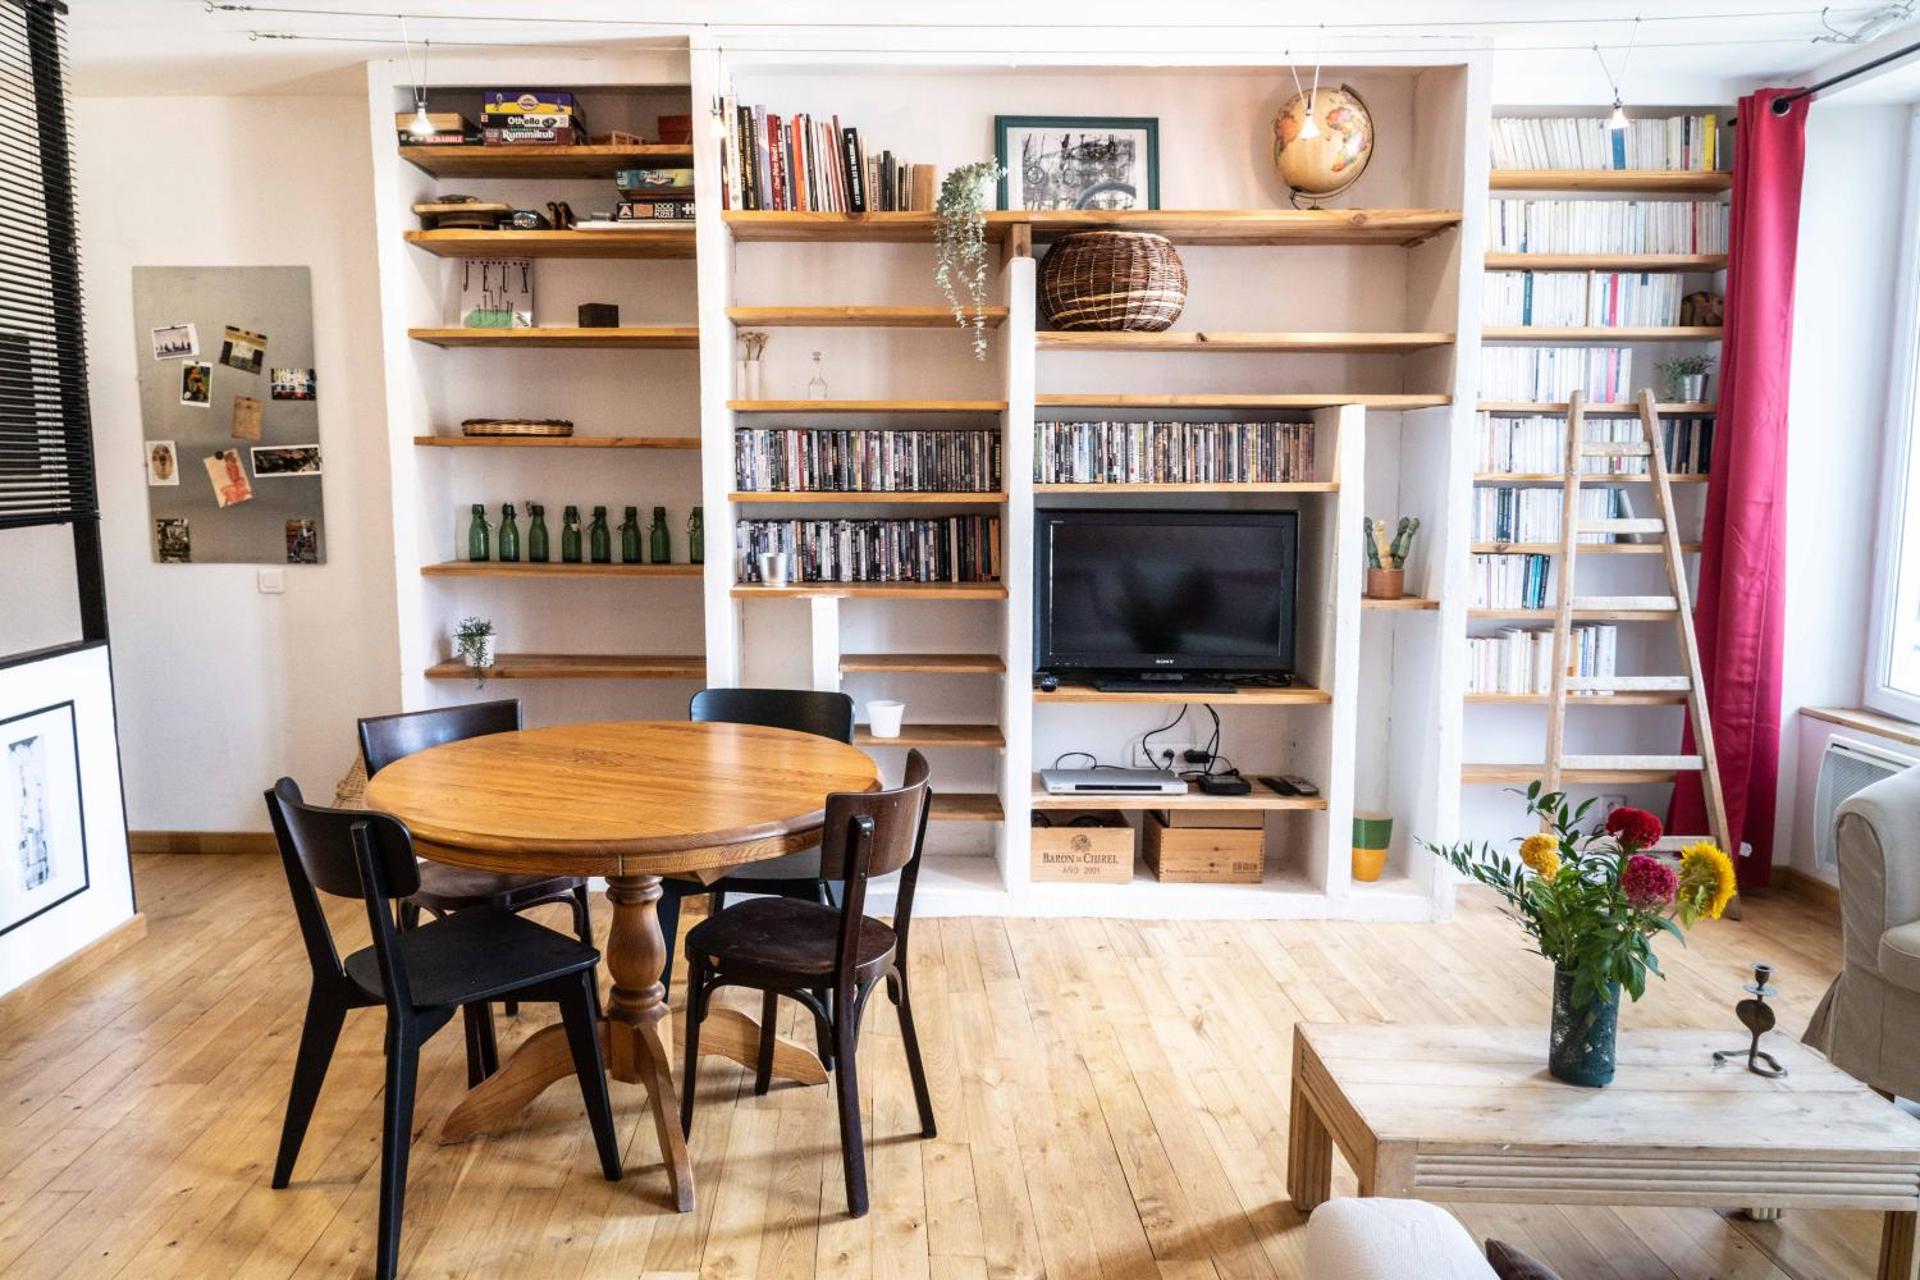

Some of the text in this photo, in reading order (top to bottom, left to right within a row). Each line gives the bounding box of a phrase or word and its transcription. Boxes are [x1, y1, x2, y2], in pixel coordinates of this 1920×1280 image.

[508, 116, 540, 125] Othello
[502, 129, 555, 142] Rummikub
[1043, 852, 1075, 864] BARON
